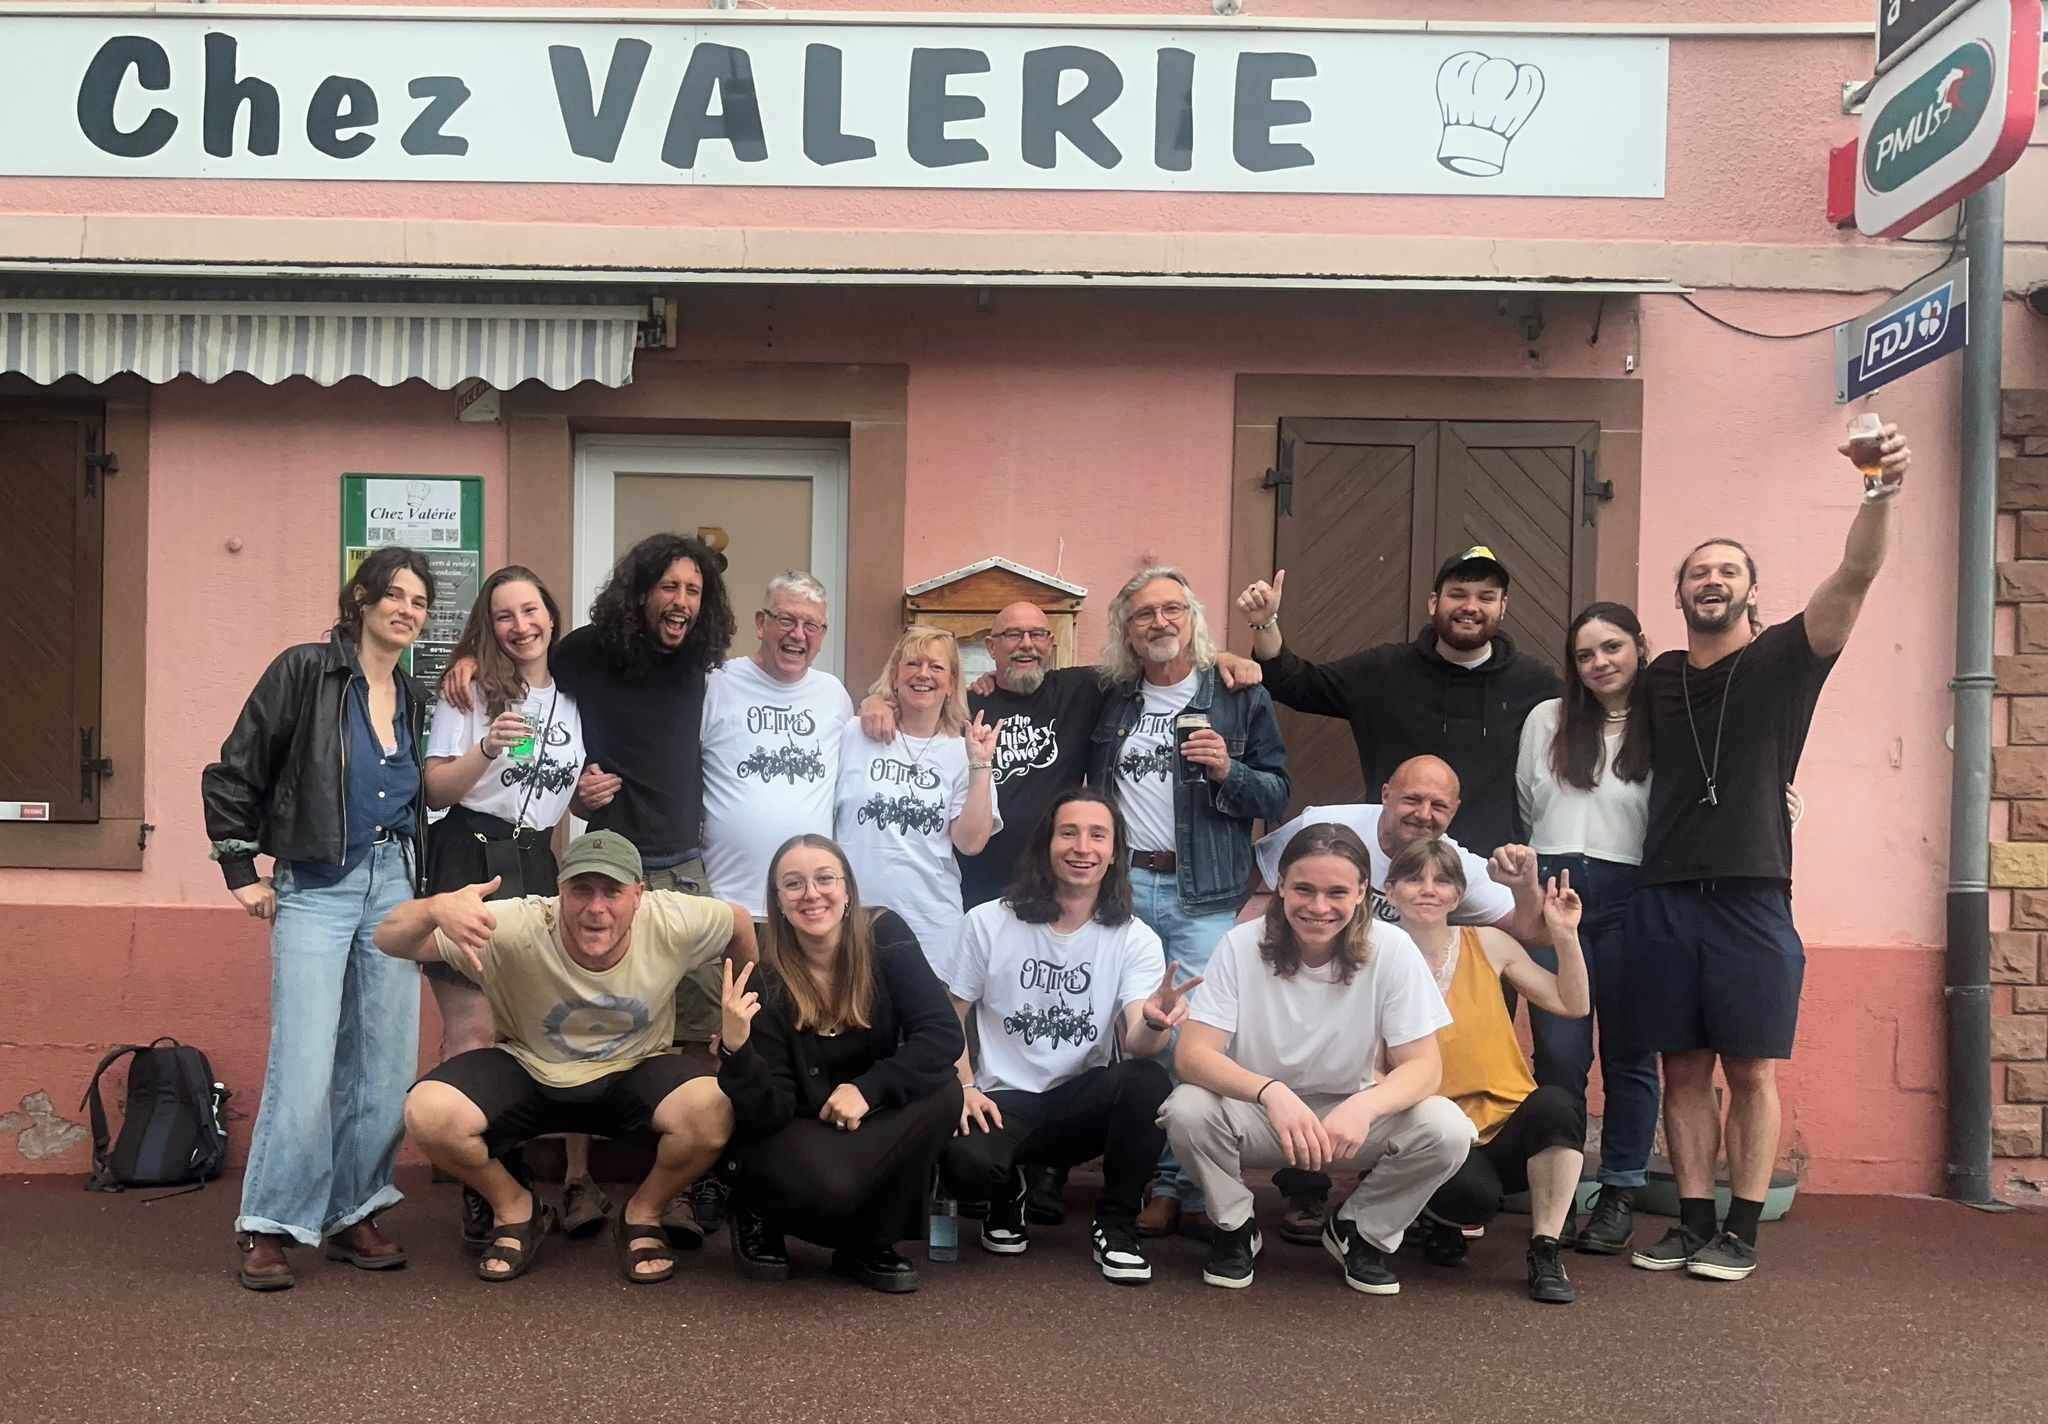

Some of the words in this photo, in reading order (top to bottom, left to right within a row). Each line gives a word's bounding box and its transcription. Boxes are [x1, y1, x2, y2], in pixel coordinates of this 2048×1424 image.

[77, 32, 470, 159] Chez
[549, 38, 1316, 172] VALERIE
[1876, 103, 1934, 172] PMU
[1867, 312, 1916, 367] FDJ
[370, 507, 403, 520] Chez
[408, 507, 457, 520] Valérie
[992, 740, 1050, 769] lower
[1000, 725, 1056, 747] hisky
